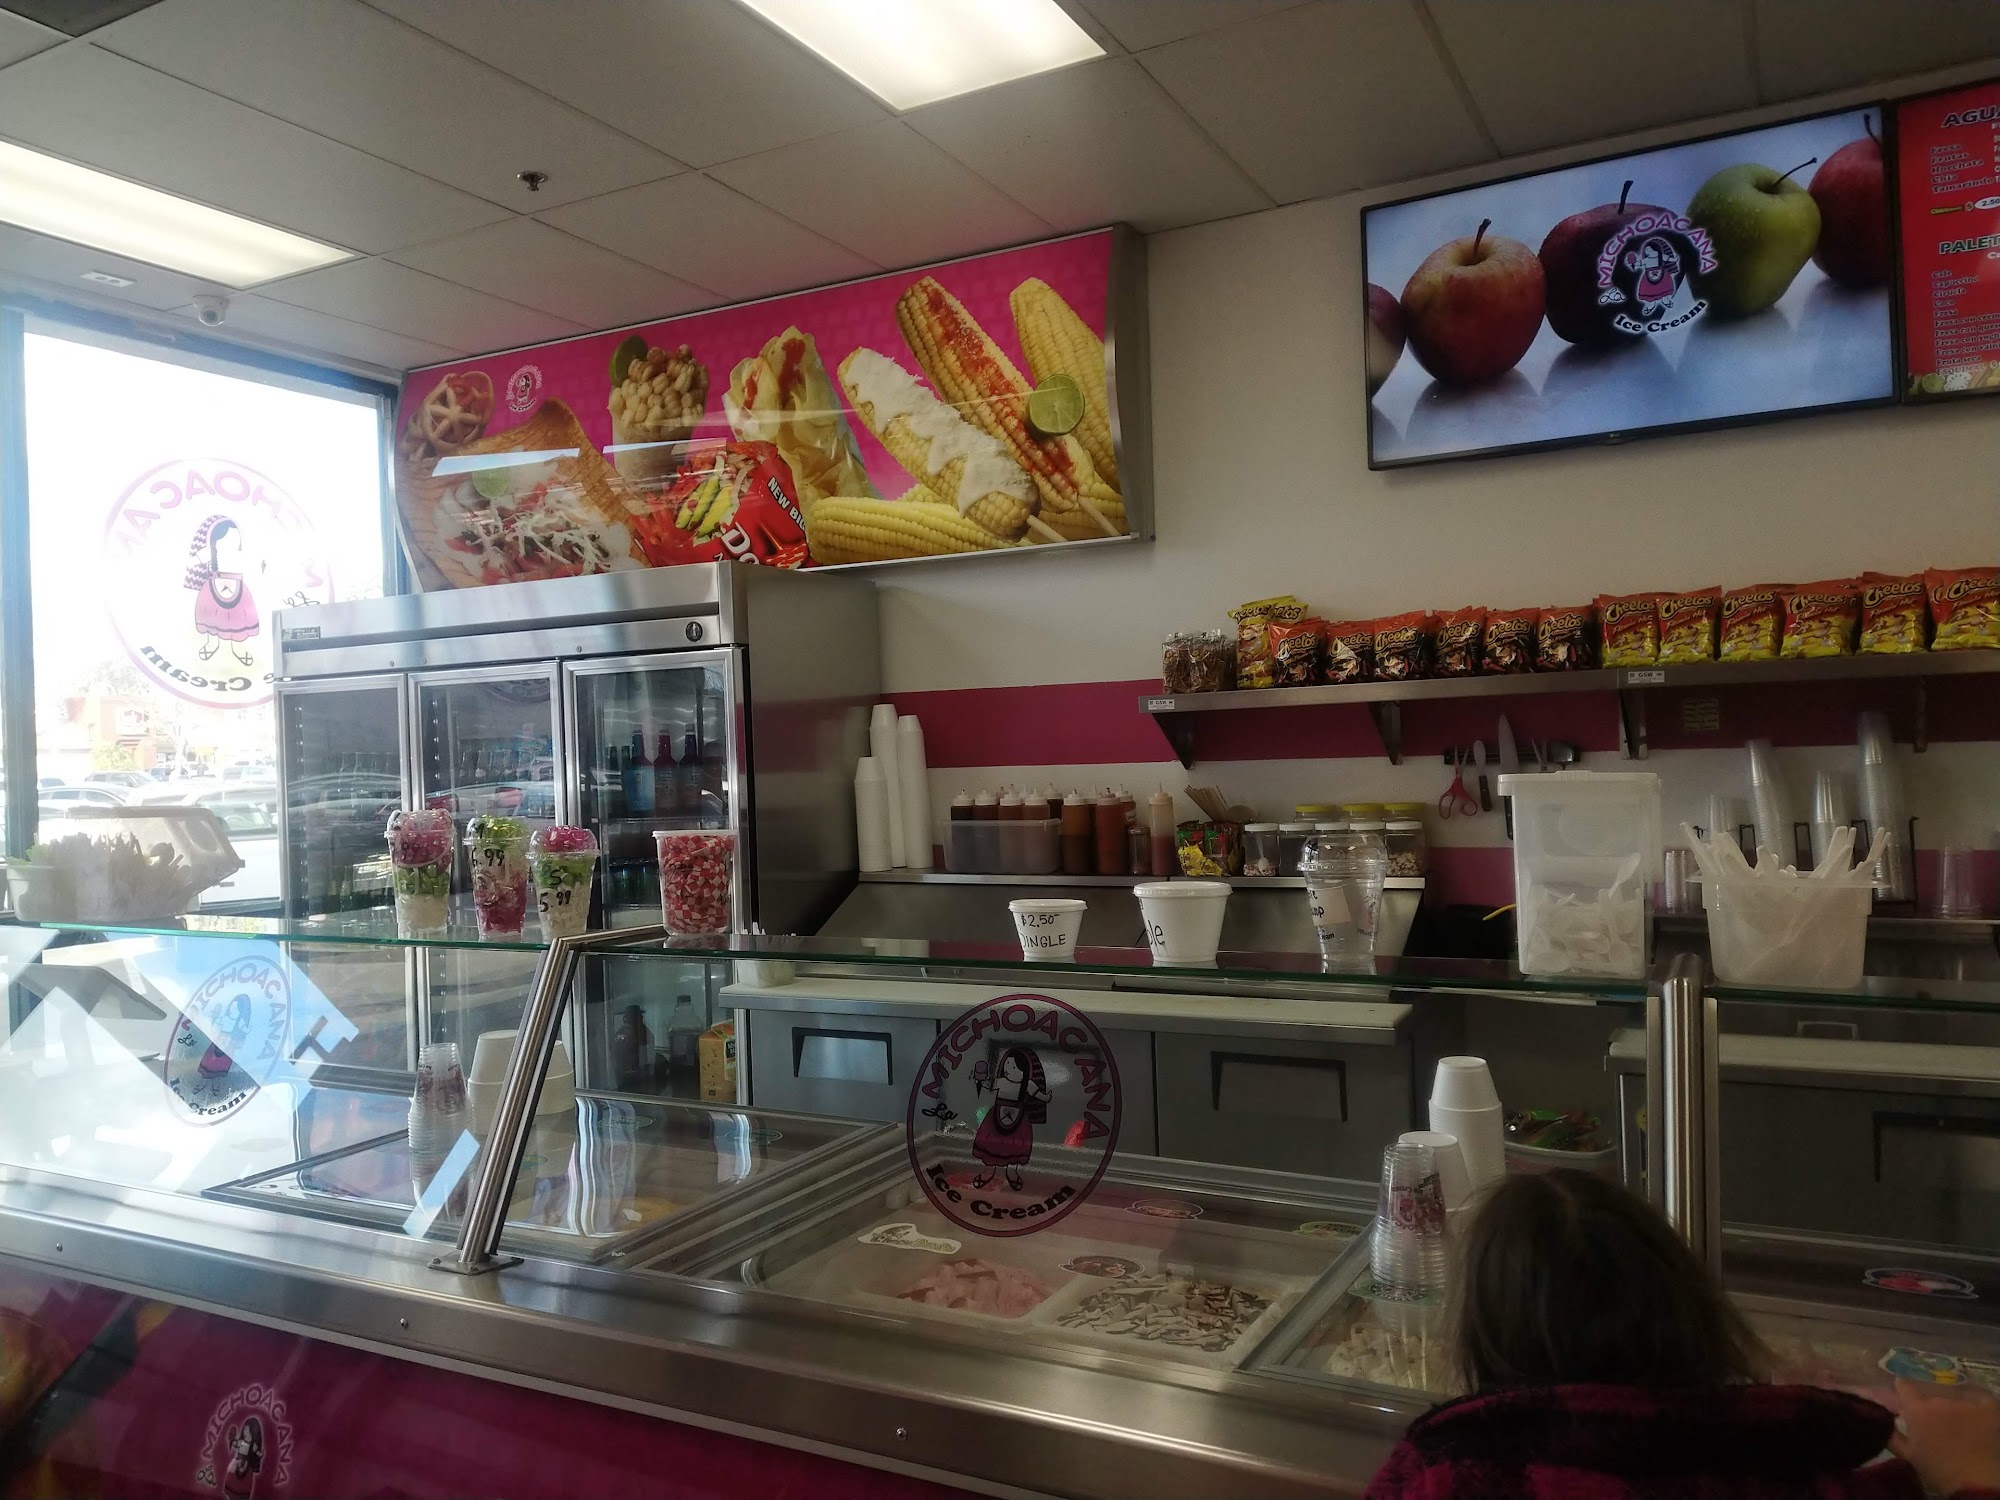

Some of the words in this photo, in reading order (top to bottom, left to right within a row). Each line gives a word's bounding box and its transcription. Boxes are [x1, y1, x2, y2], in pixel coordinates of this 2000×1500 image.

[1941, 105, 2000, 128] AGU
[1931, 159, 1984, 174] Horchata
[1931, 177, 1994, 194] Tamarindo
[1597, 213, 1718, 288] MICHOACANA
[1933, 300, 1955, 308] Coco
[1614, 316, 1642, 333] Ice
[1647, 300, 1708, 333] Cream
[1934, 319, 1959, 328] Fresa
[1960, 316, 1976, 324] con
[1935, 329, 1959, 338] Fresa
[1935, 339, 1960, 347] Fresa
[1935, 349, 1960, 357] Fresa
[767, 476, 790, 510] NEW
[1721, 592, 1776, 618] Cheetos
[1789, 593, 1846, 614] Cheetos
[1863, 582, 1922, 608] Cheetos
[1606, 601, 1656, 623] Cheetos
[1660, 596, 1714, 620] Cheetos
[1438, 621, 1480, 650] Cheetos
[1486, 618, 1530, 646] Cheetos
[1539, 614, 1584, 641] Cheetos
[1279, 633, 1319, 658] Cheetos
[1374, 627, 1418, 653] Cheetos
[540, 890, 572, 912] 5.99
[922, 1003, 1112, 1140] MICHOACANA
[921, 1103, 958, 1121] La
[926, 1163, 963, 1204] Ice
[969, 1185, 1077, 1220] Cream
[200, 1382, 294, 1486] MICHOACANA
